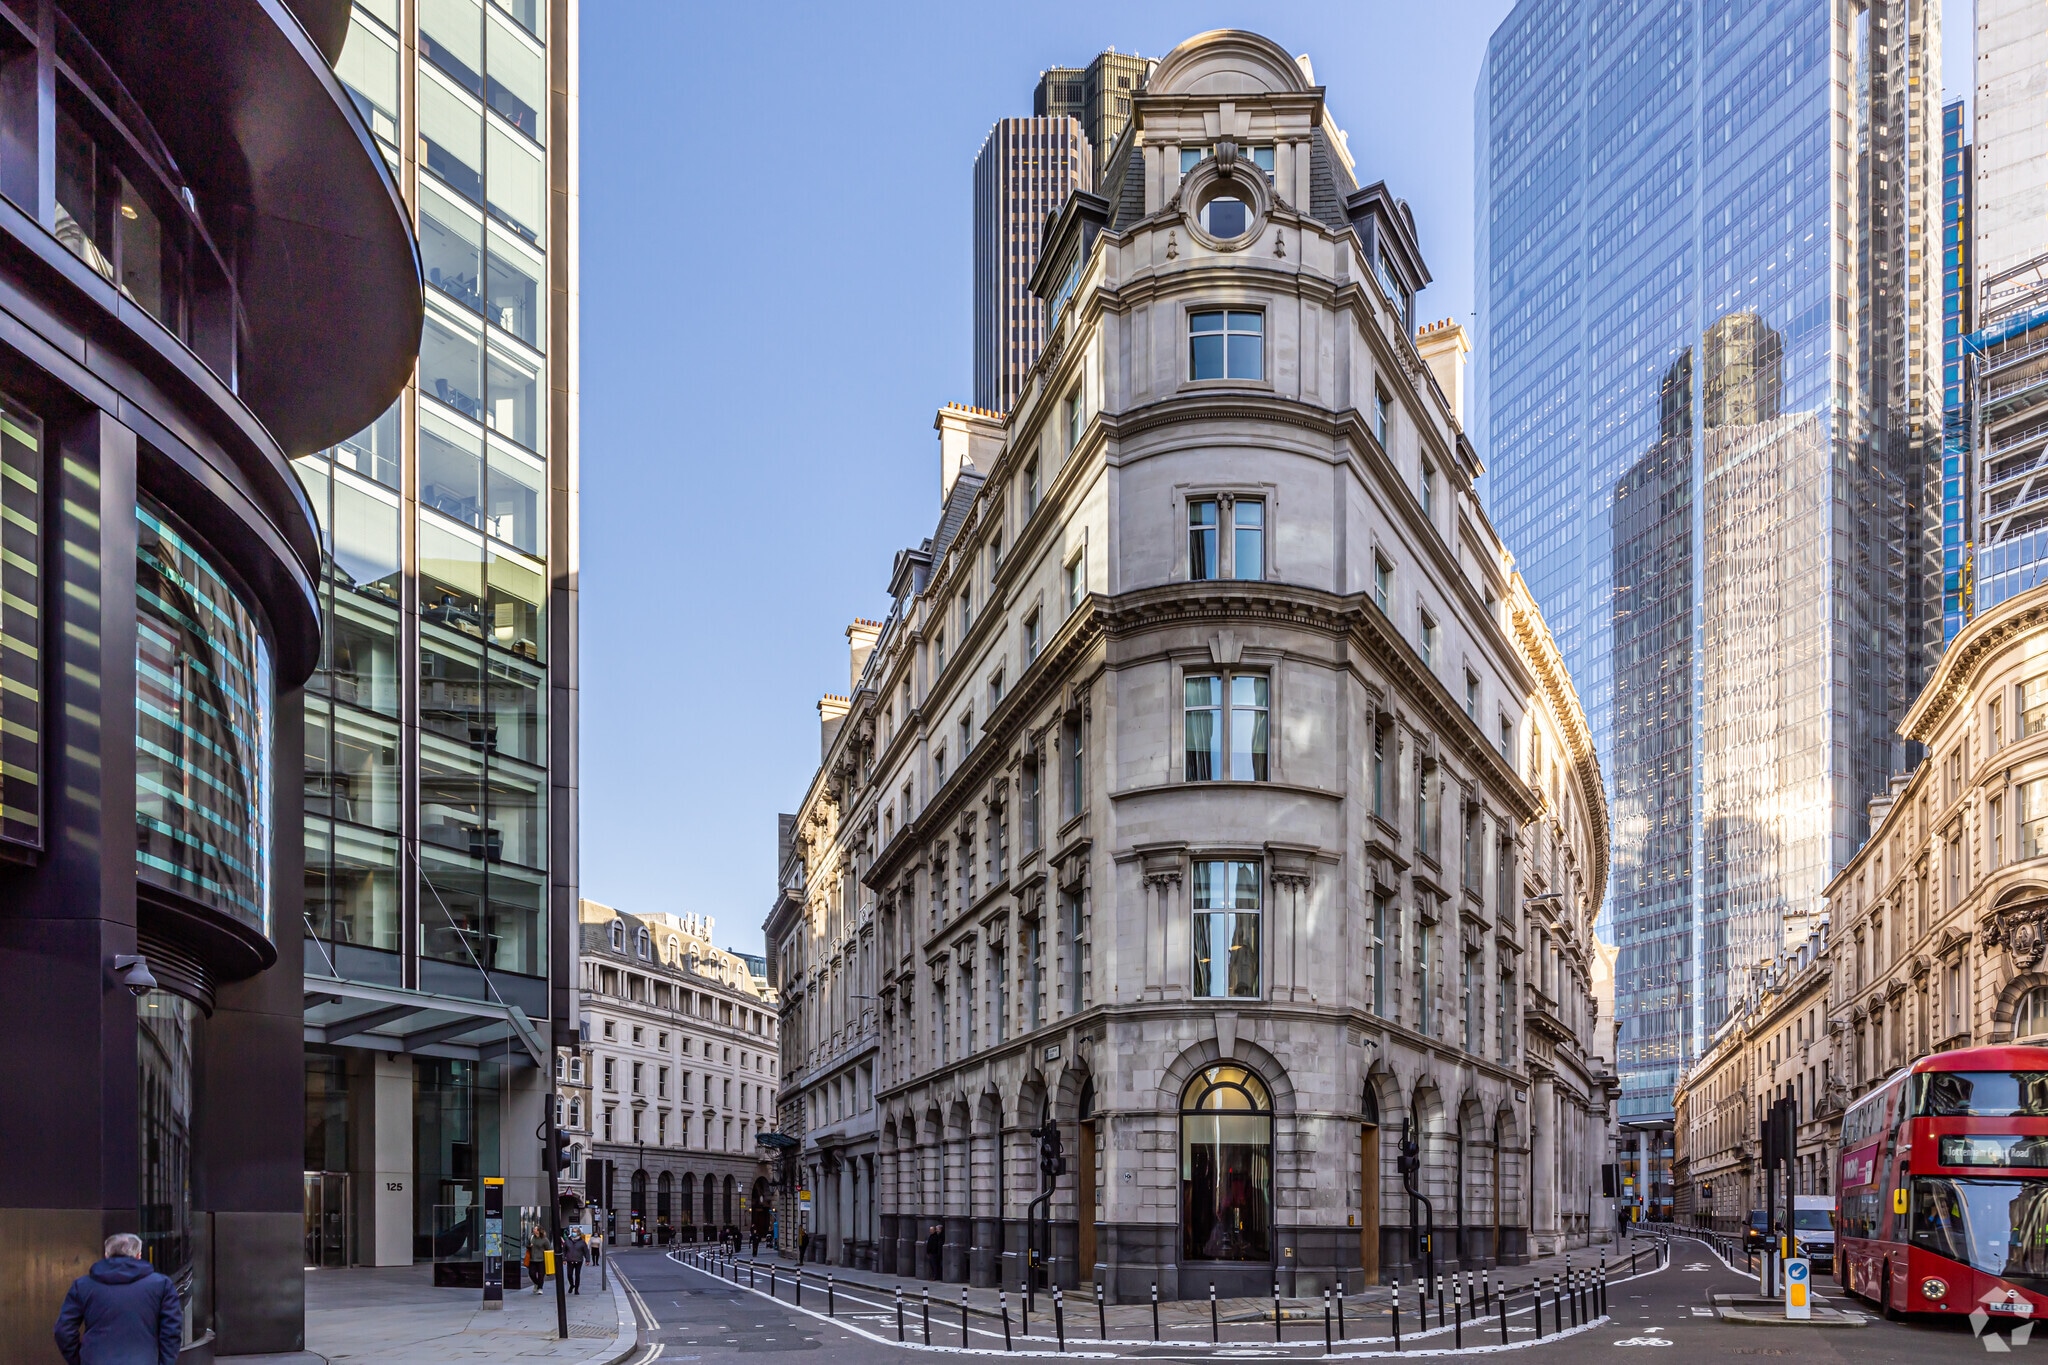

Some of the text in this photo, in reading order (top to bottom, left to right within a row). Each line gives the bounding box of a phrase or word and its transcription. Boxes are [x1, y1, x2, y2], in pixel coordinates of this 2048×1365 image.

[1948, 1146, 1987, 1157] Tottenham
[2011, 1147, 2030, 1158] Road
[386, 1182, 403, 1191] 125
